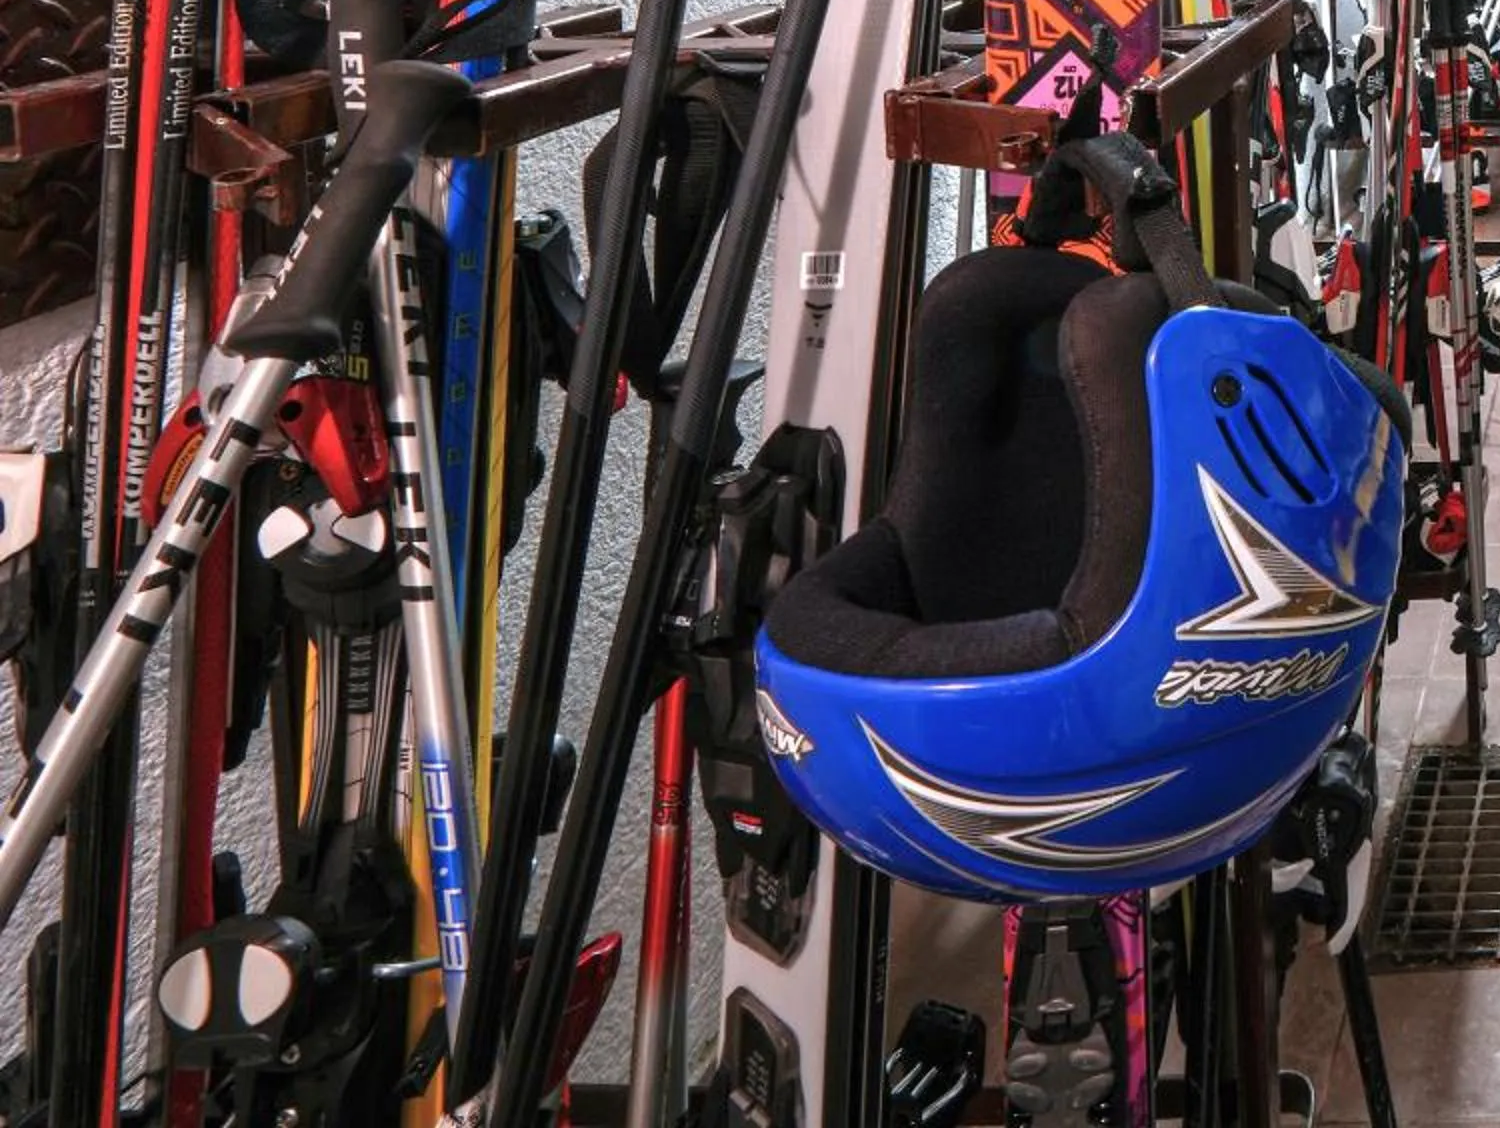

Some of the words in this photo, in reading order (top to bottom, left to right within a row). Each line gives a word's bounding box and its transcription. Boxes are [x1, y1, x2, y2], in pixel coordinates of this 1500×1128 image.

[110, 0, 135, 70] Edition
[337, 30, 366, 111] LEKI
[104, 76, 130, 151] Limited
[163, 66, 193, 141] Limited
[124, 311, 163, 518] KOMPERDELL
[117, 418, 261, 644] LEKI
[389, 422, 434, 601] LEKI
